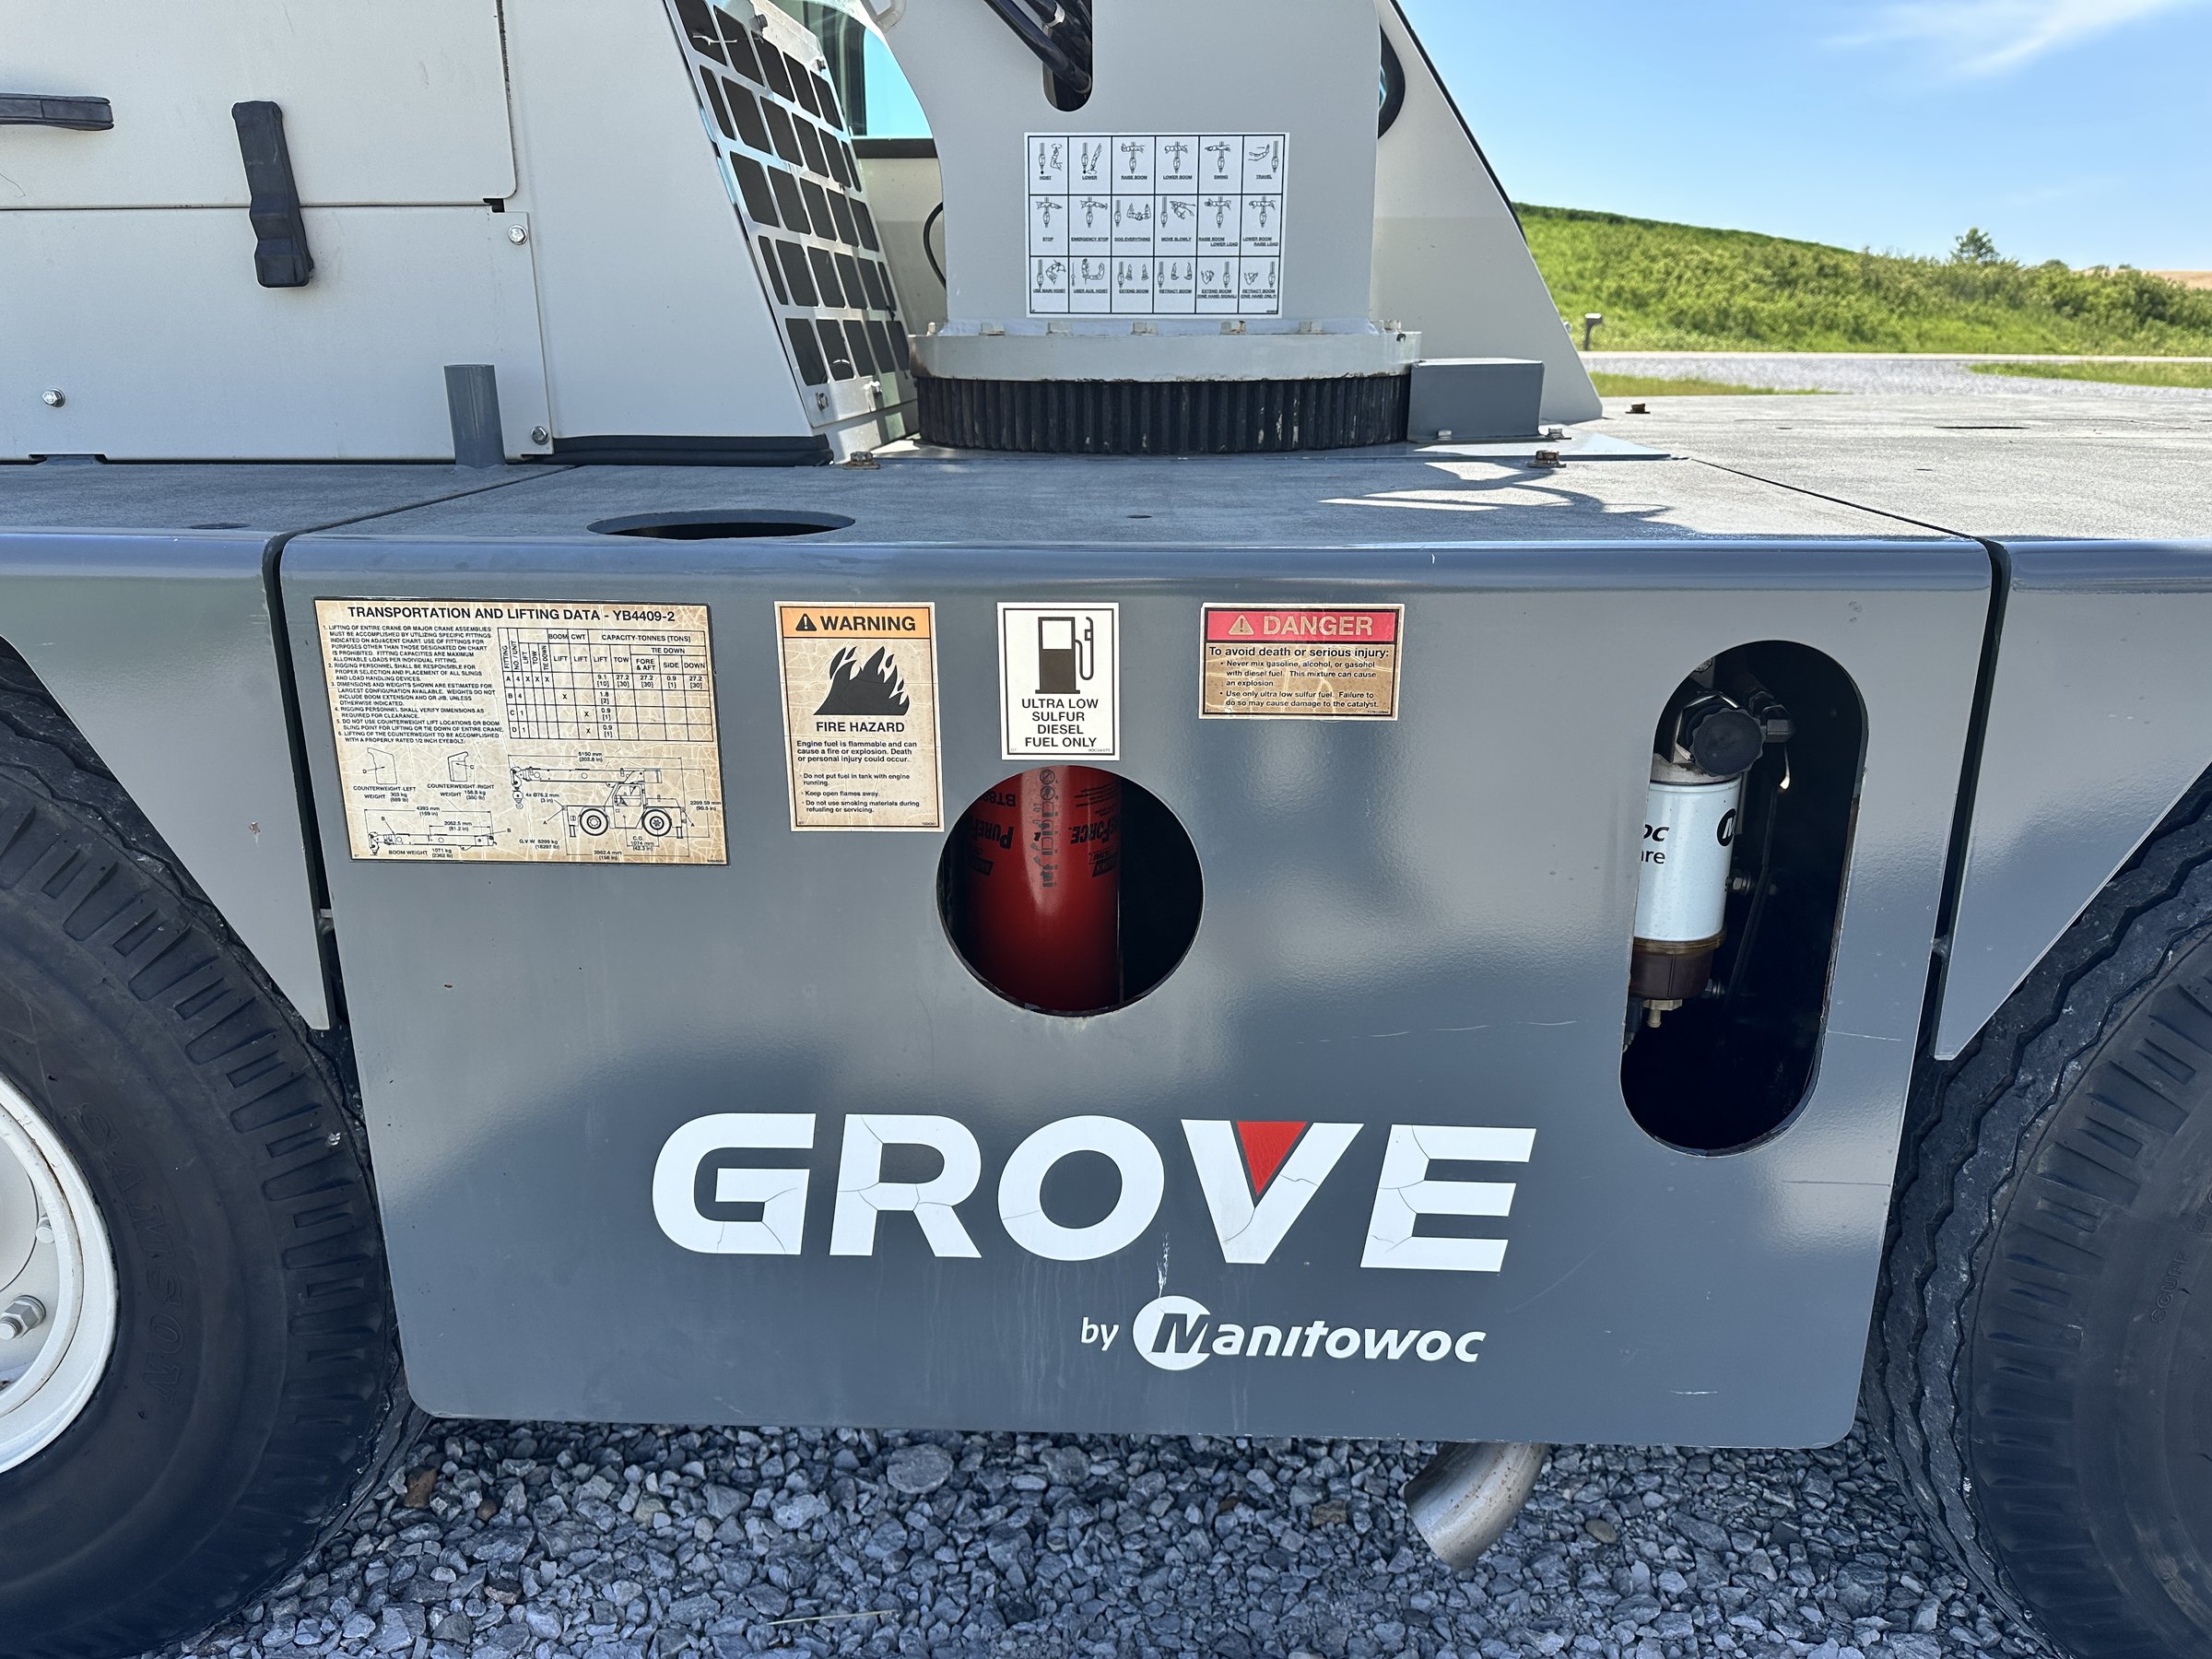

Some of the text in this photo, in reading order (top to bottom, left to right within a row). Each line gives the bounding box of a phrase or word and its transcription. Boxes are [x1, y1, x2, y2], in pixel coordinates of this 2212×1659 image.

[347, 606, 472, 619] TRANSPORTATION
[474, 607, 504, 619] AND
[507, 608, 560, 620] LIFTING
[563, 609, 601, 620] DATA
[612, 609, 676, 622] YB4409-2
[819, 616, 916, 631] WARNING
[1263, 615, 1373, 636] DANGER
[601, 634, 691, 643] CAPACITY-TONNES [TONS]
[501, 645, 510, 669] FITTING
[1209, 647, 1222, 656] To
[1225, 647, 1255, 656] avoid
[1258, 647, 1291, 656] death
[1309, 648, 1351, 657] serious
[1354, 648, 1389, 659] injury:
[1241, 690, 1258, 699] only
[1021, 698, 1099, 709] ULTRA LOW
[1031, 712, 1085, 722] SULFUR
[816, 722, 905, 733] FIRE HAZARD
[1037, 724, 1084, 735] DIESEL
[1025, 737, 1097, 747] FUEL ONLY
[652, 1112, 1537, 1273] GROVE
[1080, 1295, 1487, 1371] by Manitowoc
